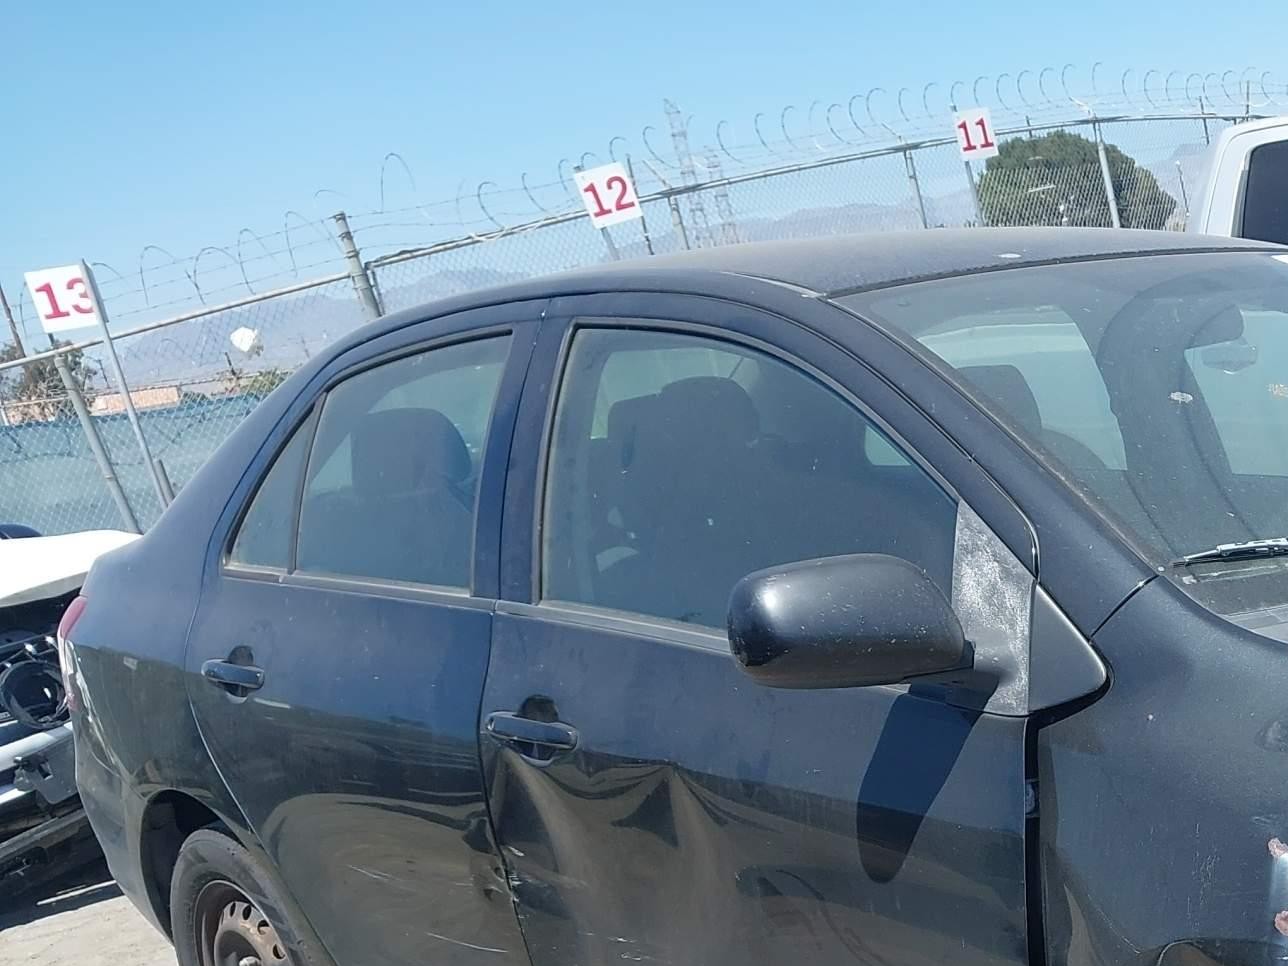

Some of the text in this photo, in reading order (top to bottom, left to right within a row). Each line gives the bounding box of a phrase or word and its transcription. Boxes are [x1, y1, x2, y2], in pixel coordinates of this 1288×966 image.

[957, 117, 995, 152] 11
[583, 175, 636, 218] 12
[34, 277, 96, 320] 13
